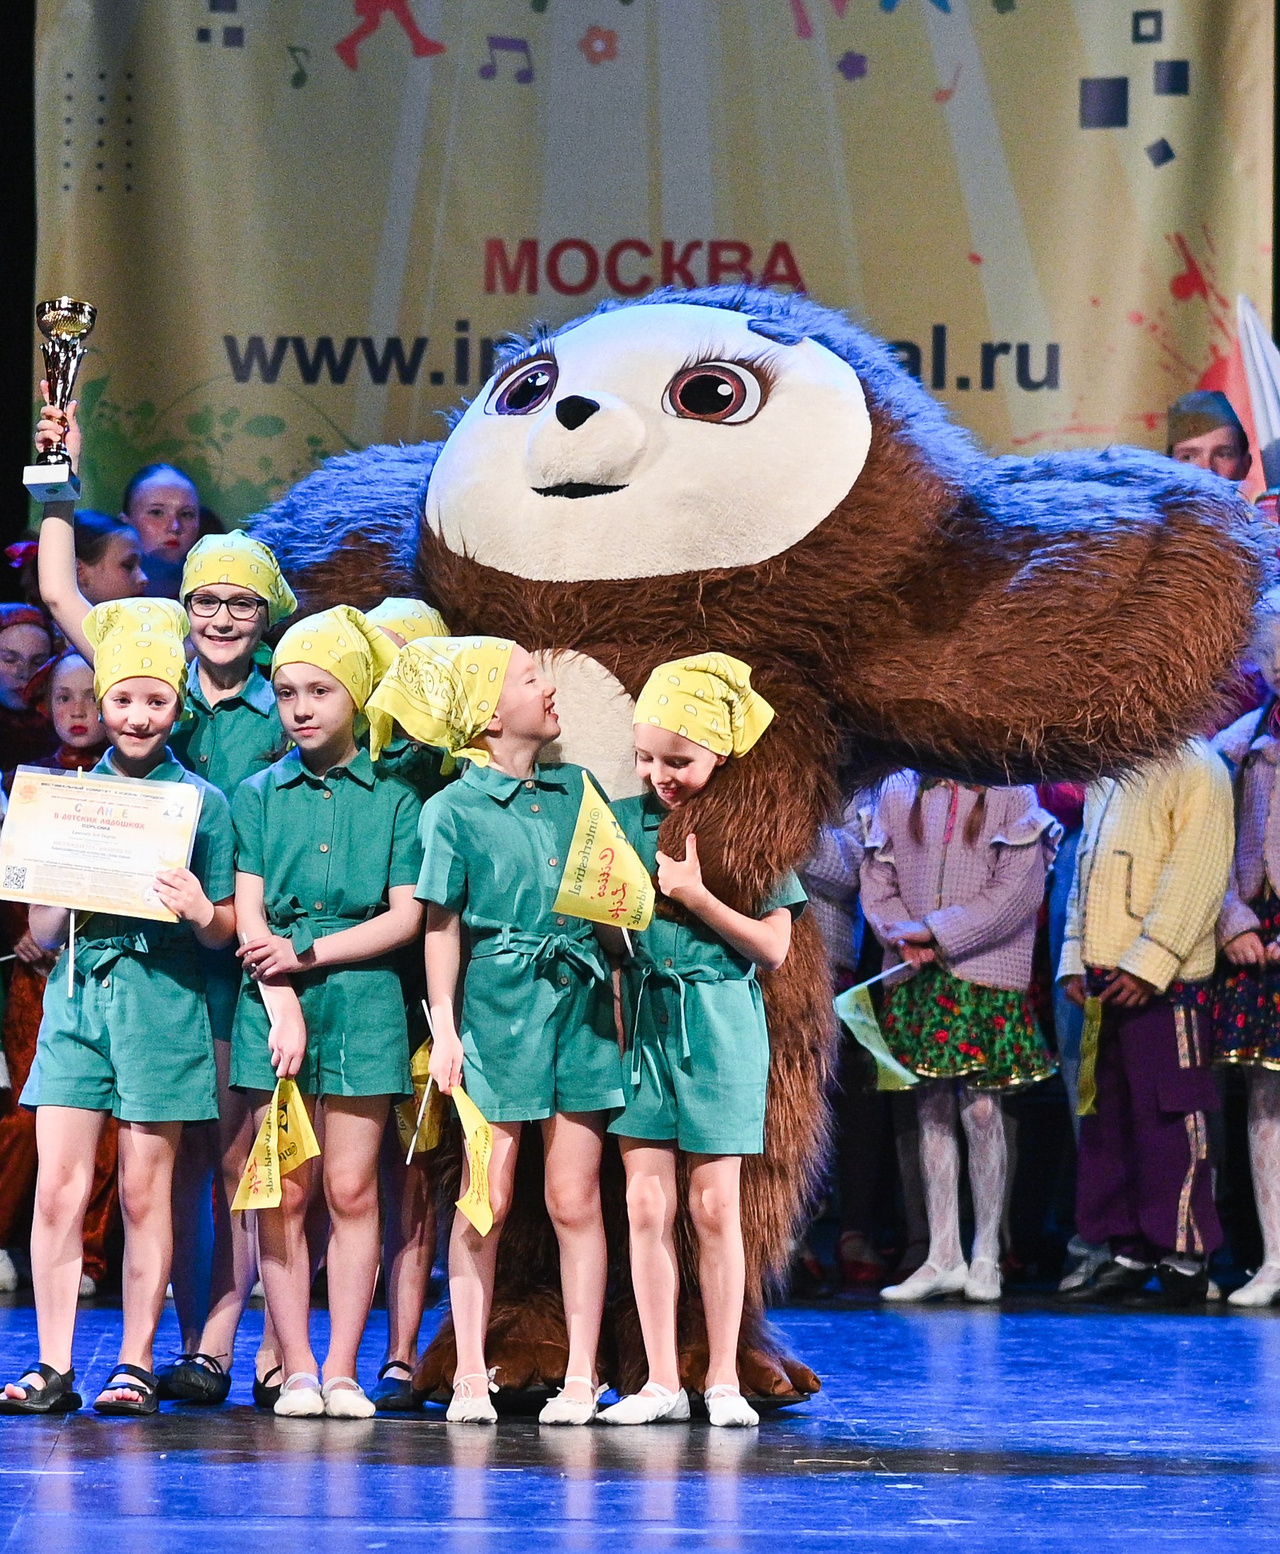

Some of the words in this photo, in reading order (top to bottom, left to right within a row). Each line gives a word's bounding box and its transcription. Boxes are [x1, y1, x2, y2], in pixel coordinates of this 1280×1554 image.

[483, 238, 807, 296] МОСКВА
[61, 814, 97, 823] детских
[100, 818, 145, 829] ладошках
